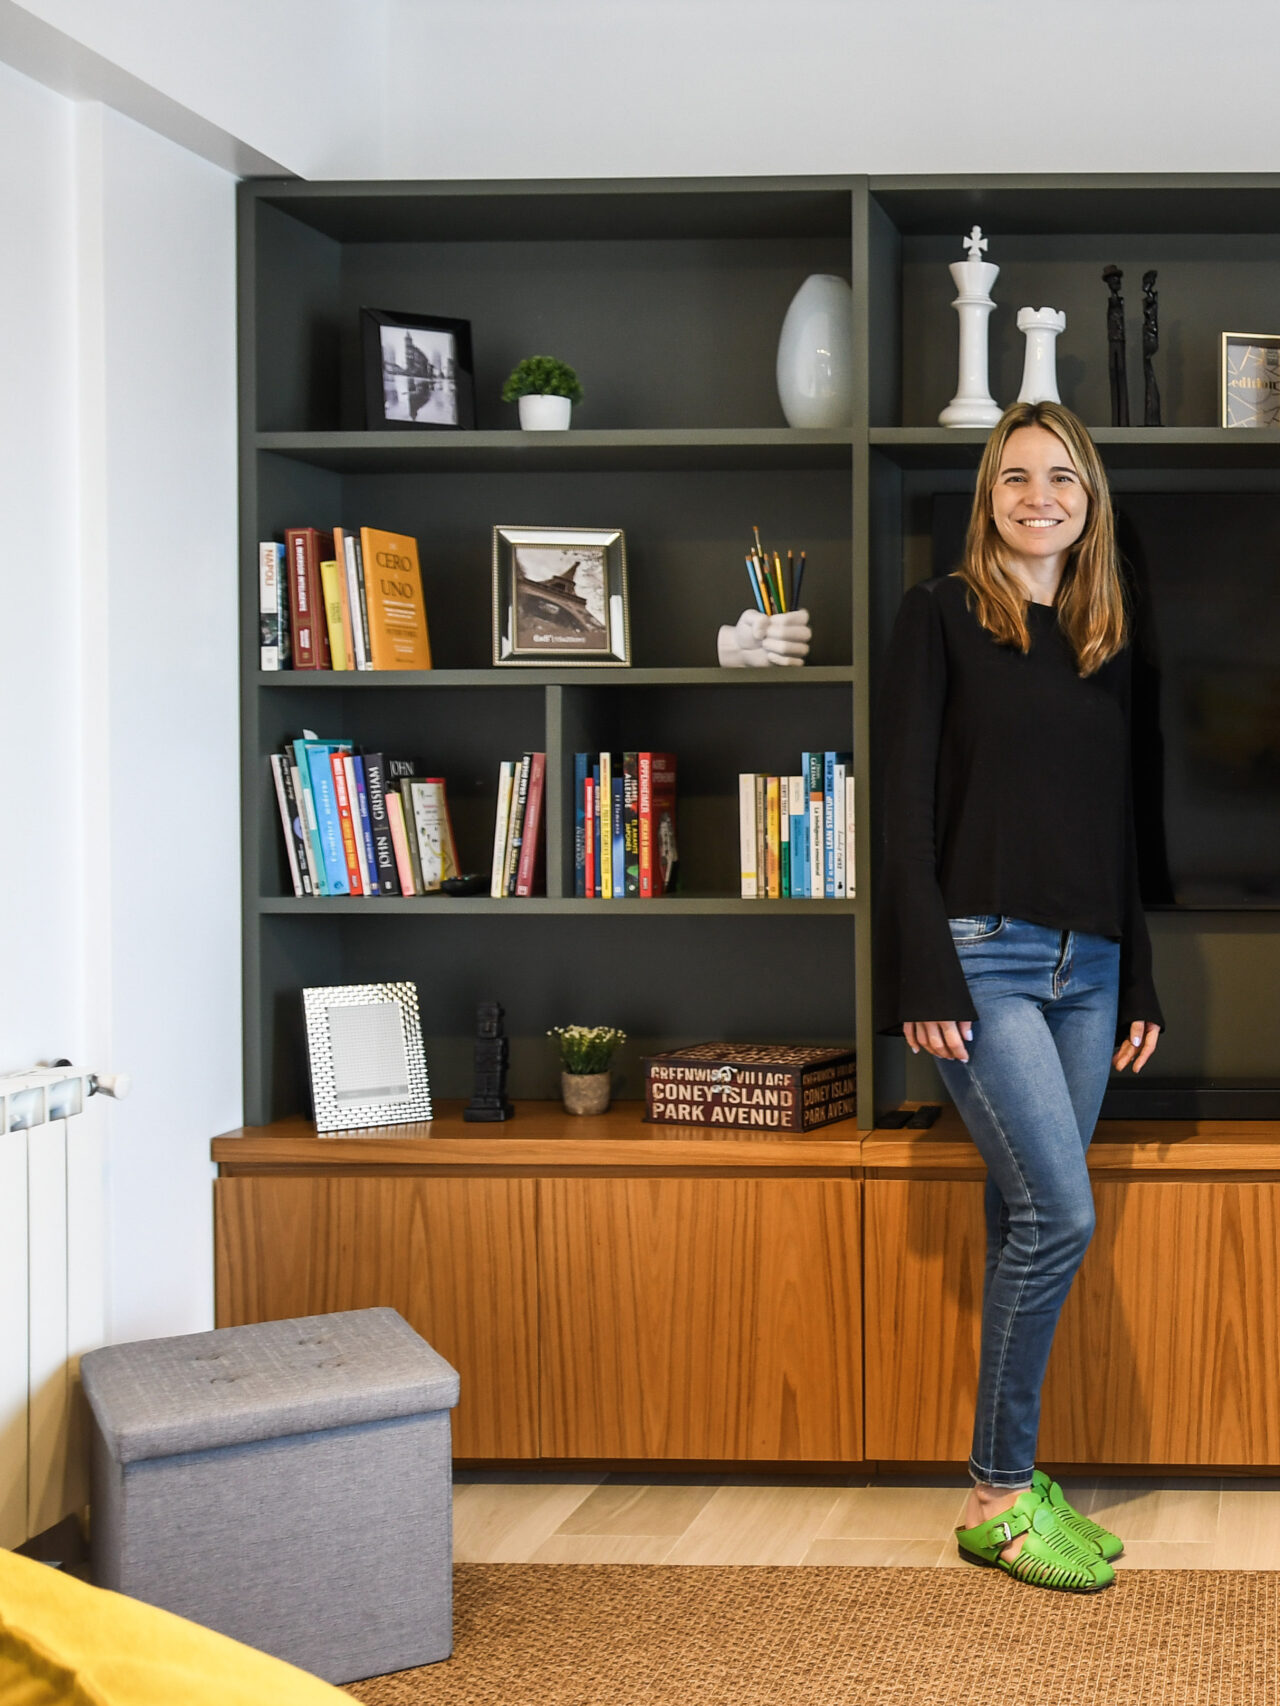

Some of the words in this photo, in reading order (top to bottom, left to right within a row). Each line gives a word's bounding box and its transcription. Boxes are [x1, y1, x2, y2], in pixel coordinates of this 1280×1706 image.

[264, 549, 274, 586] NAPOLI
[376, 551, 412, 572] CERO
[380, 579, 413, 599] UNO
[389, 760, 415, 777] JOHN
[368, 767, 384, 820] GRISHAM
[640, 759, 650, 813] OPPENHEIMER
[376, 836, 392, 868] JOHN
[651, 1067, 729, 1082] GREENWI
[736, 1071, 792, 1086] VILLAGE
[652, 1083, 713, 1102] CONEY
[721, 1086, 793, 1107] ISLAND
[652, 1102, 705, 1122] PARK
[710, 1106, 792, 1127] AVENUE
[803, 1105, 826, 1127] PARK
